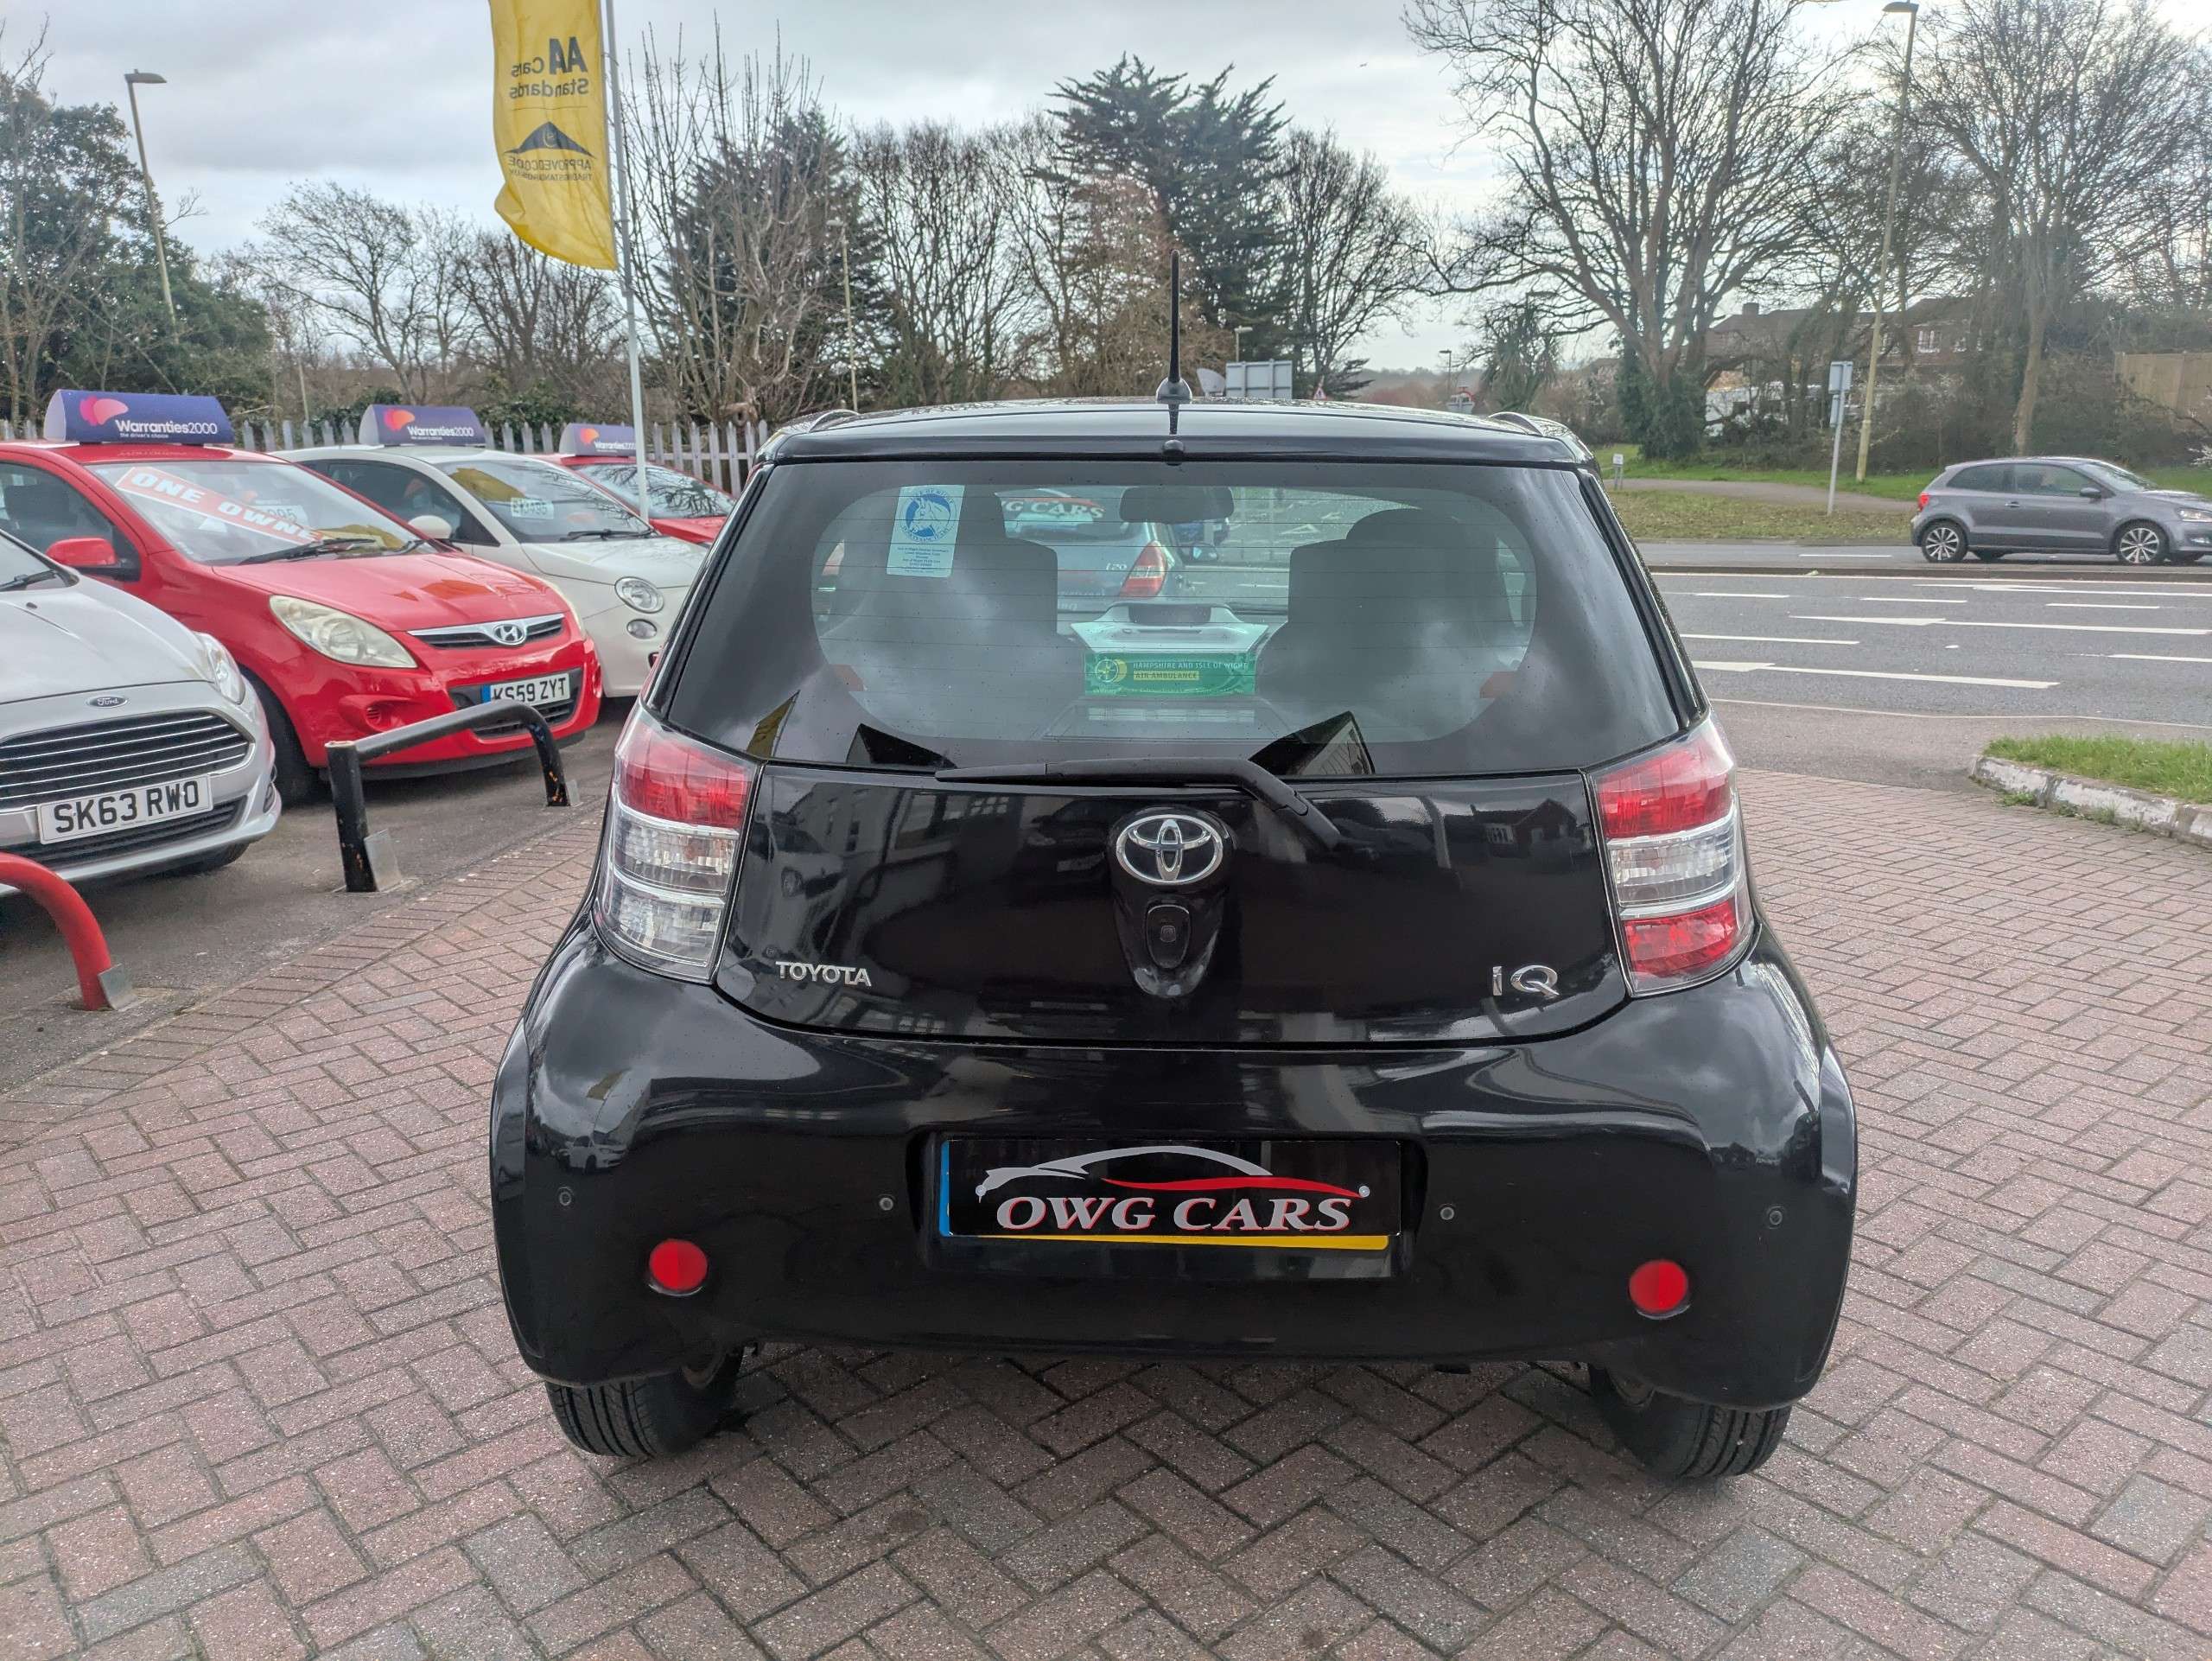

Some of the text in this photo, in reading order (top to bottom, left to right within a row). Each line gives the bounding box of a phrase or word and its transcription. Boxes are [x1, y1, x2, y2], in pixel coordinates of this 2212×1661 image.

[115, 419, 218, 435] Warranties2000
[131, 473, 206, 503] ONE
[1031, 500, 1104, 519] CARS
[539, 678, 566, 699] ZYT
[97, 697, 119, 706] Ford
[53, 780, 200, 834] SK63 RWO
[775, 961, 872, 987] TOYOTA
[996, 1196, 1351, 1232] OWG CARS
